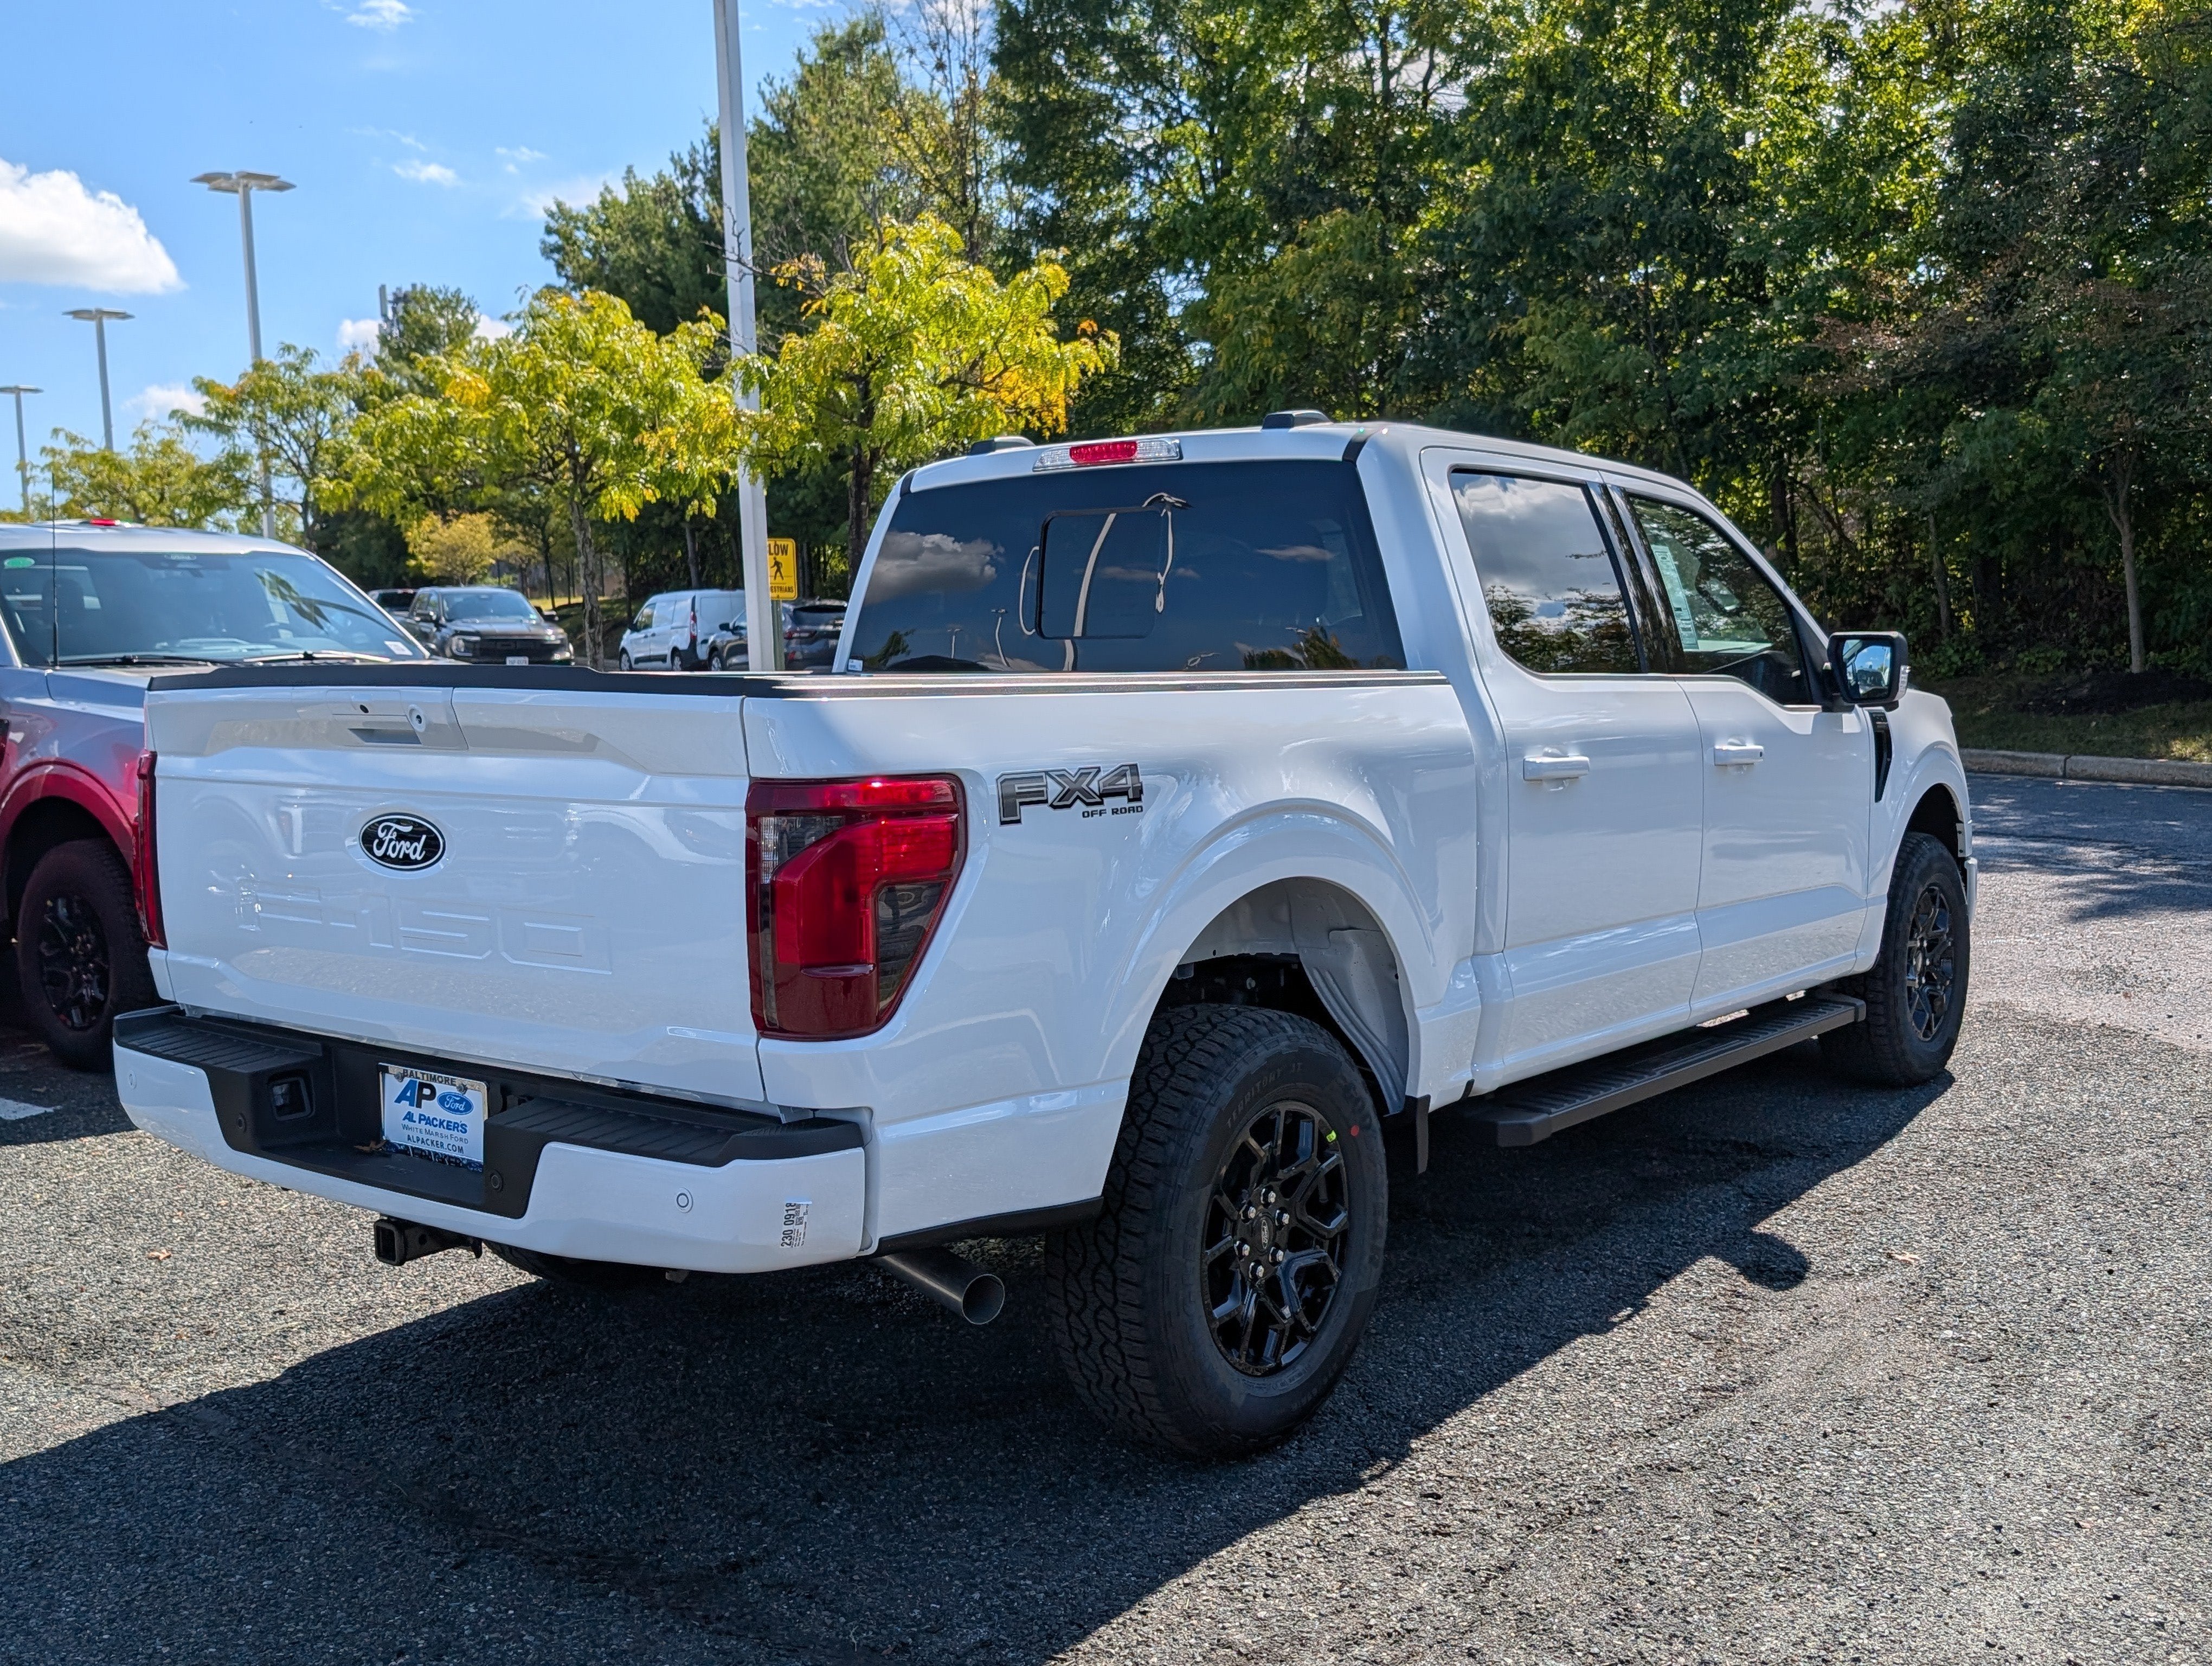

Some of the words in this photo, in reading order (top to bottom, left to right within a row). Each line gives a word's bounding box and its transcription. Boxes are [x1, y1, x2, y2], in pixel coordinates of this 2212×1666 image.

[769, 543, 788, 556] LOW
[770, 585, 794, 593] ESTRIANS
[996, 762, 1143, 825] FX4
[1082, 809, 1107, 818] OFF
[1111, 805, 1143, 816] ROAD
[373, 822, 427, 860] Ford
[403, 1069, 456, 1085] BALTIMORE
[394, 1079, 436, 1108] AP
[444, 1094, 466, 1111] Ford
[402, 1111, 416, 1123] AL
[419, 1113, 468, 1134] PACKER'S
[401, 1123, 423, 1134] WHITE
[425, 1129, 449, 1139] MARSH
[449, 1133, 468, 1144] FORD
[407, 1134, 464, 1154] ALPACKER.COM
[781, 1229, 793, 1247] 230
